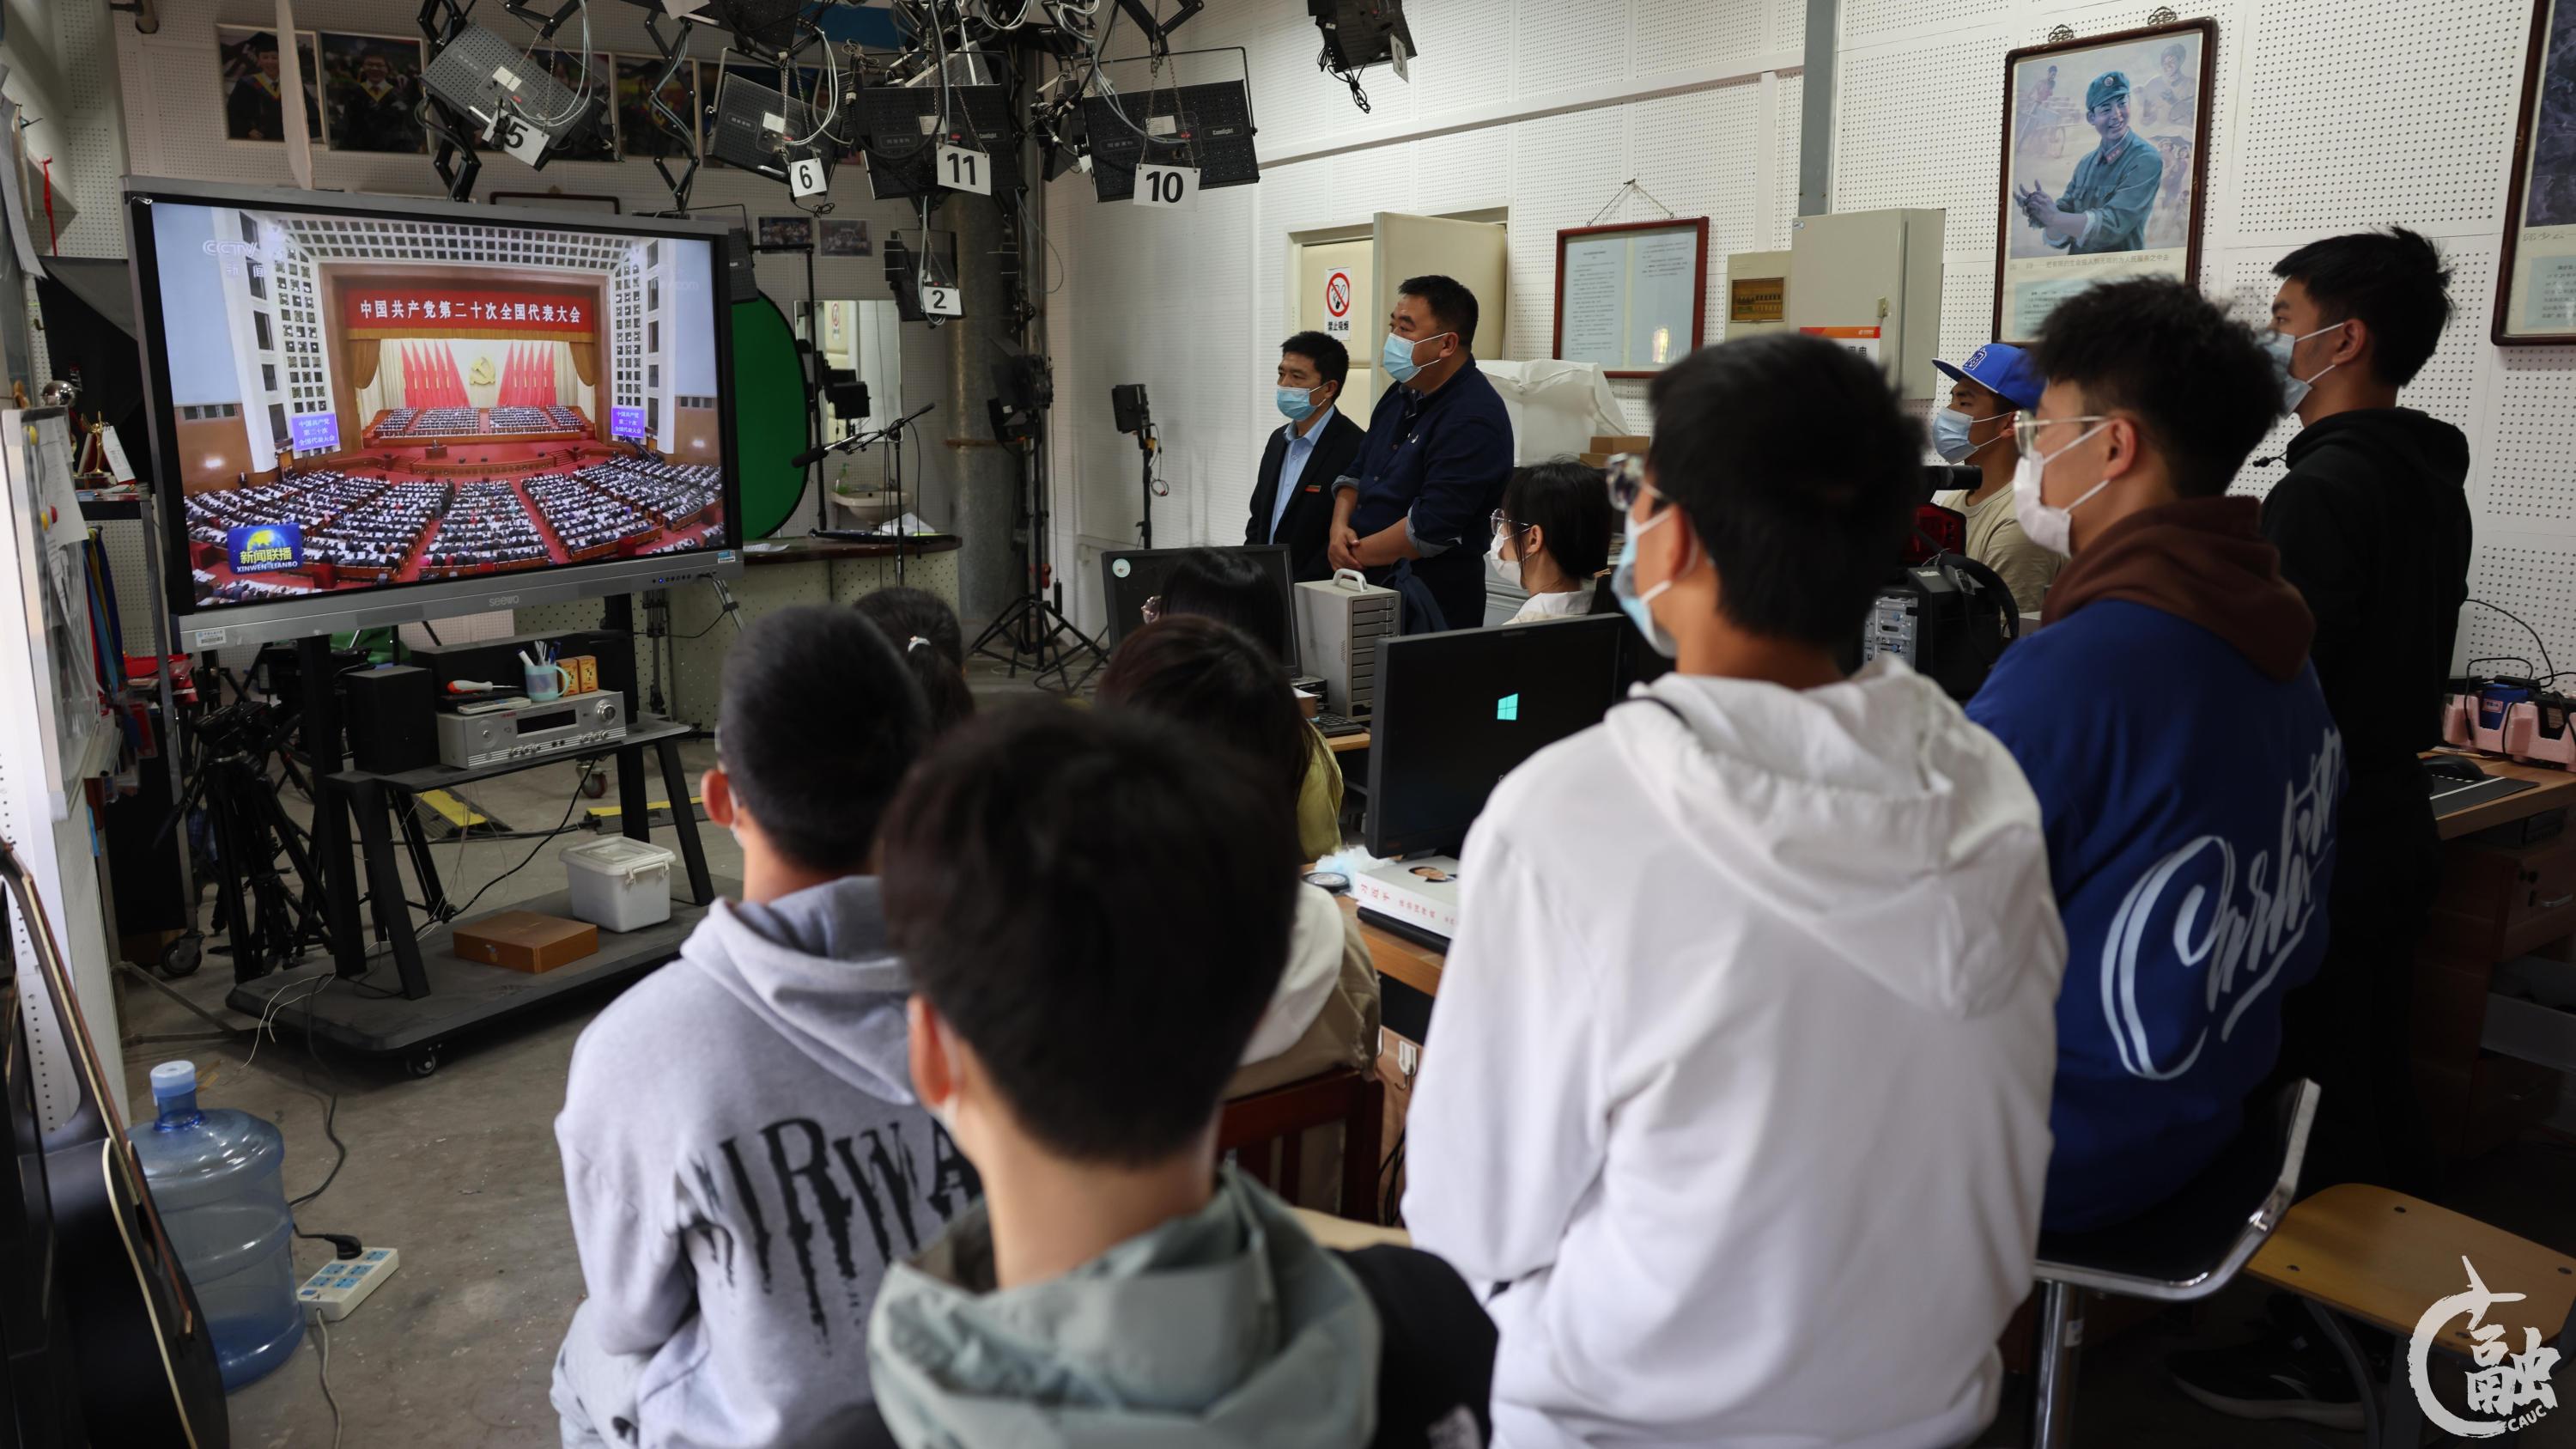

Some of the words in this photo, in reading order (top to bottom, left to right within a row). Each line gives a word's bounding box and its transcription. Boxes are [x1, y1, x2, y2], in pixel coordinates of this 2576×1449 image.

[1395, 43, 1403, 72] 9
[504, 119, 529, 149] 5
[799, 164, 813, 190] 6
[947, 153, 976, 186] 11
[1146, 171, 1184, 204] 10
[203, 240, 258, 258] CCTV
[360, 299, 581, 324] 中国共产党第二十次全国代表大会
[932, 289, 947, 309] 2
[240, 546, 293, 564] 新闻联播
